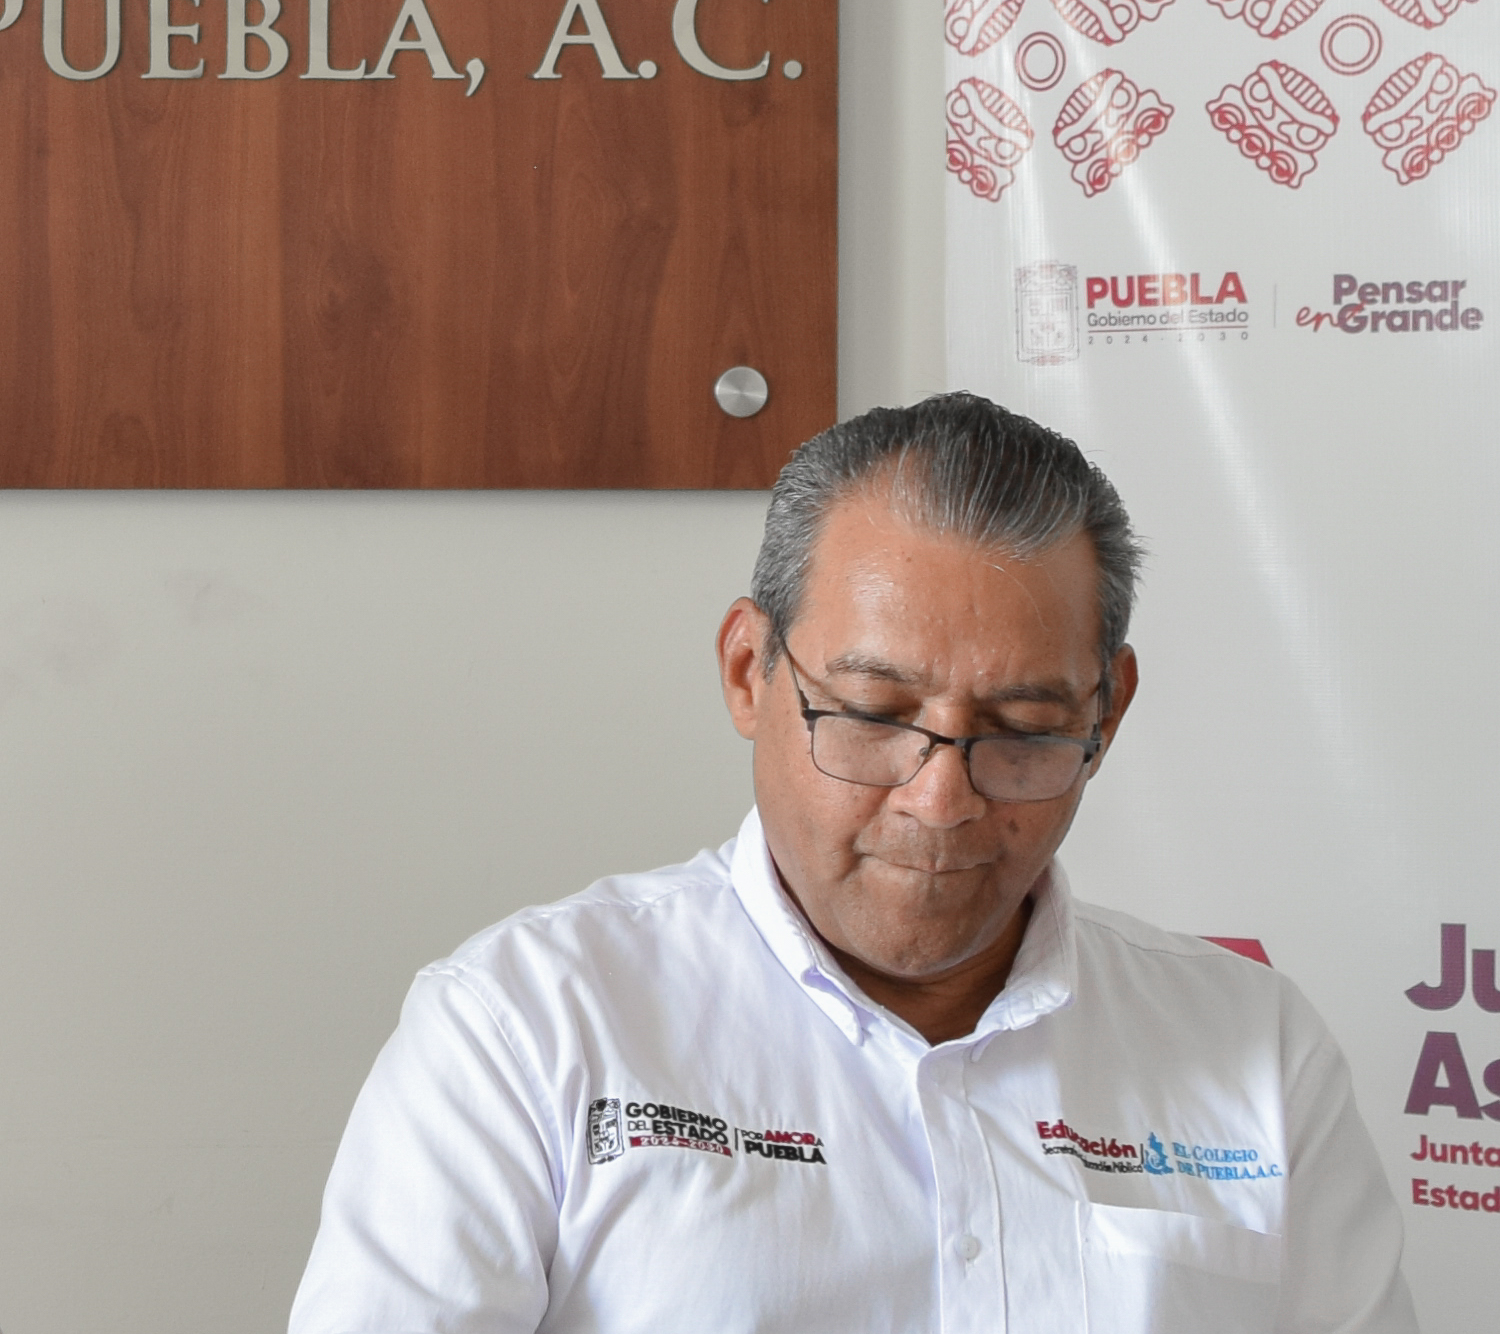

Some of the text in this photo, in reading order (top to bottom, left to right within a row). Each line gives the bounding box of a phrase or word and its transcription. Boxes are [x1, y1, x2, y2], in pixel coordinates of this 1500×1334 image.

[1085, 270, 1248, 309] PUEBLA
[1332, 273, 1467, 306] Pensar
[1087, 307, 1249, 328] Gobierno del Estado
[1339, 300, 1484, 335] Grande
[624, 1101, 728, 1133] GOBIERNO
[627, 1119, 729, 1146] DEL ESTADO
[741, 1128, 765, 1141] POR
[763, 1129, 819, 1146] AMOR
[744, 1138, 828, 1166] PUEBLA
[1192, 1144, 1259, 1164] COLEGIO
